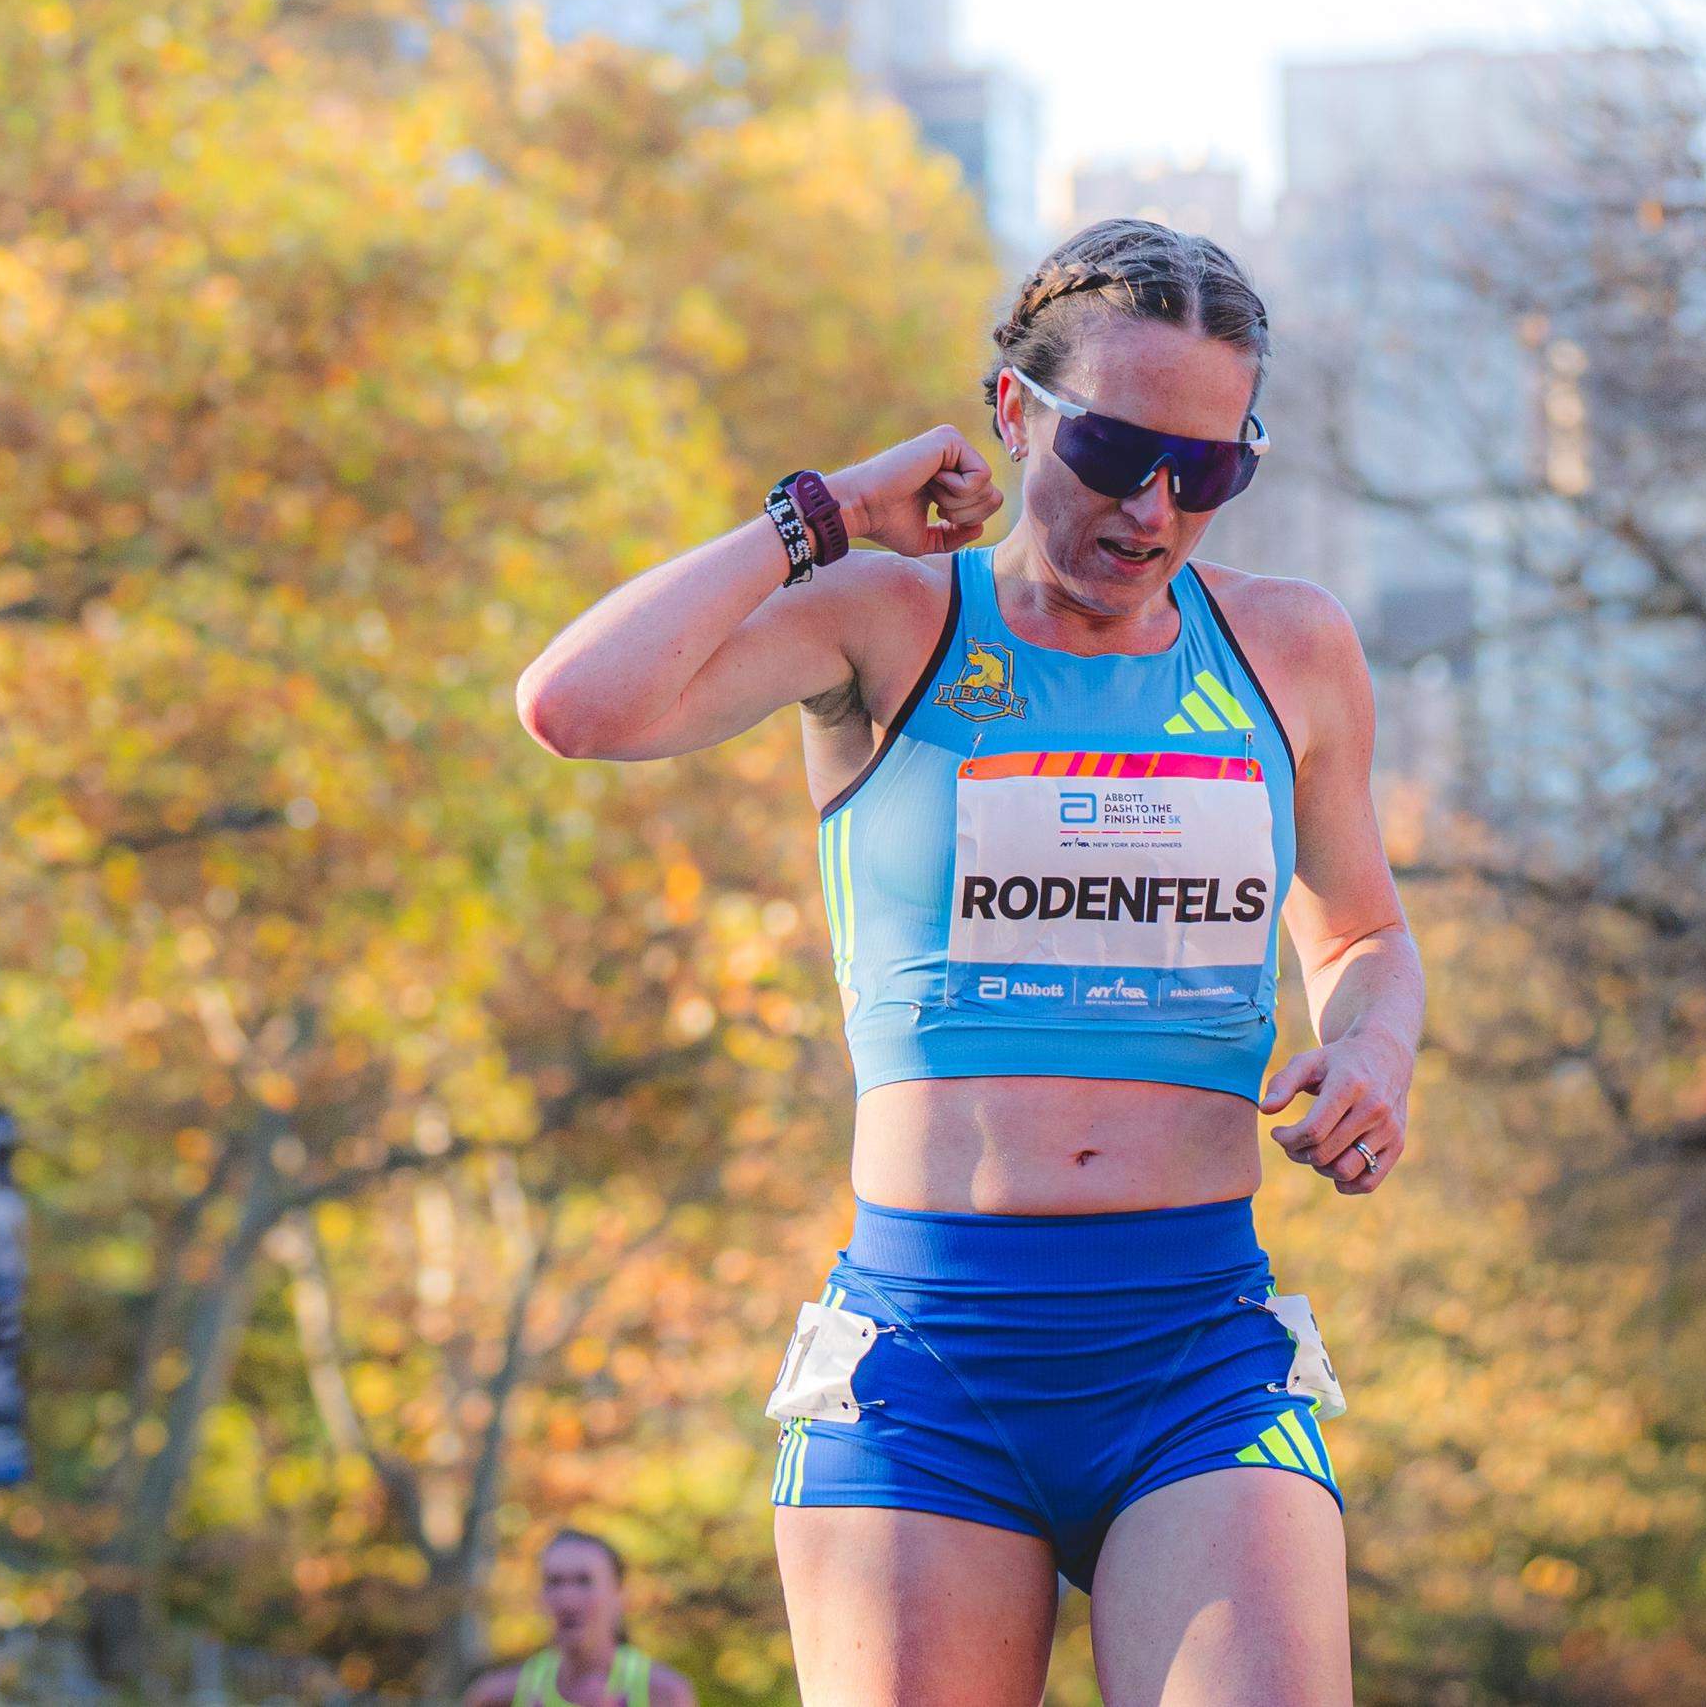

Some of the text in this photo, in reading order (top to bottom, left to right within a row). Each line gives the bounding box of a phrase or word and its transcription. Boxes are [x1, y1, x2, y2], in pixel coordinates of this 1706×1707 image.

[1104, 793, 1143, 803] ABBOTT
[1104, 803, 1172, 814] DASH TO THE
[1104, 814, 1182, 825] FINISH LINE 5K
[961, 875, 1268, 924] RODENFELS
[1010, 981, 1065, 998] Abbott
